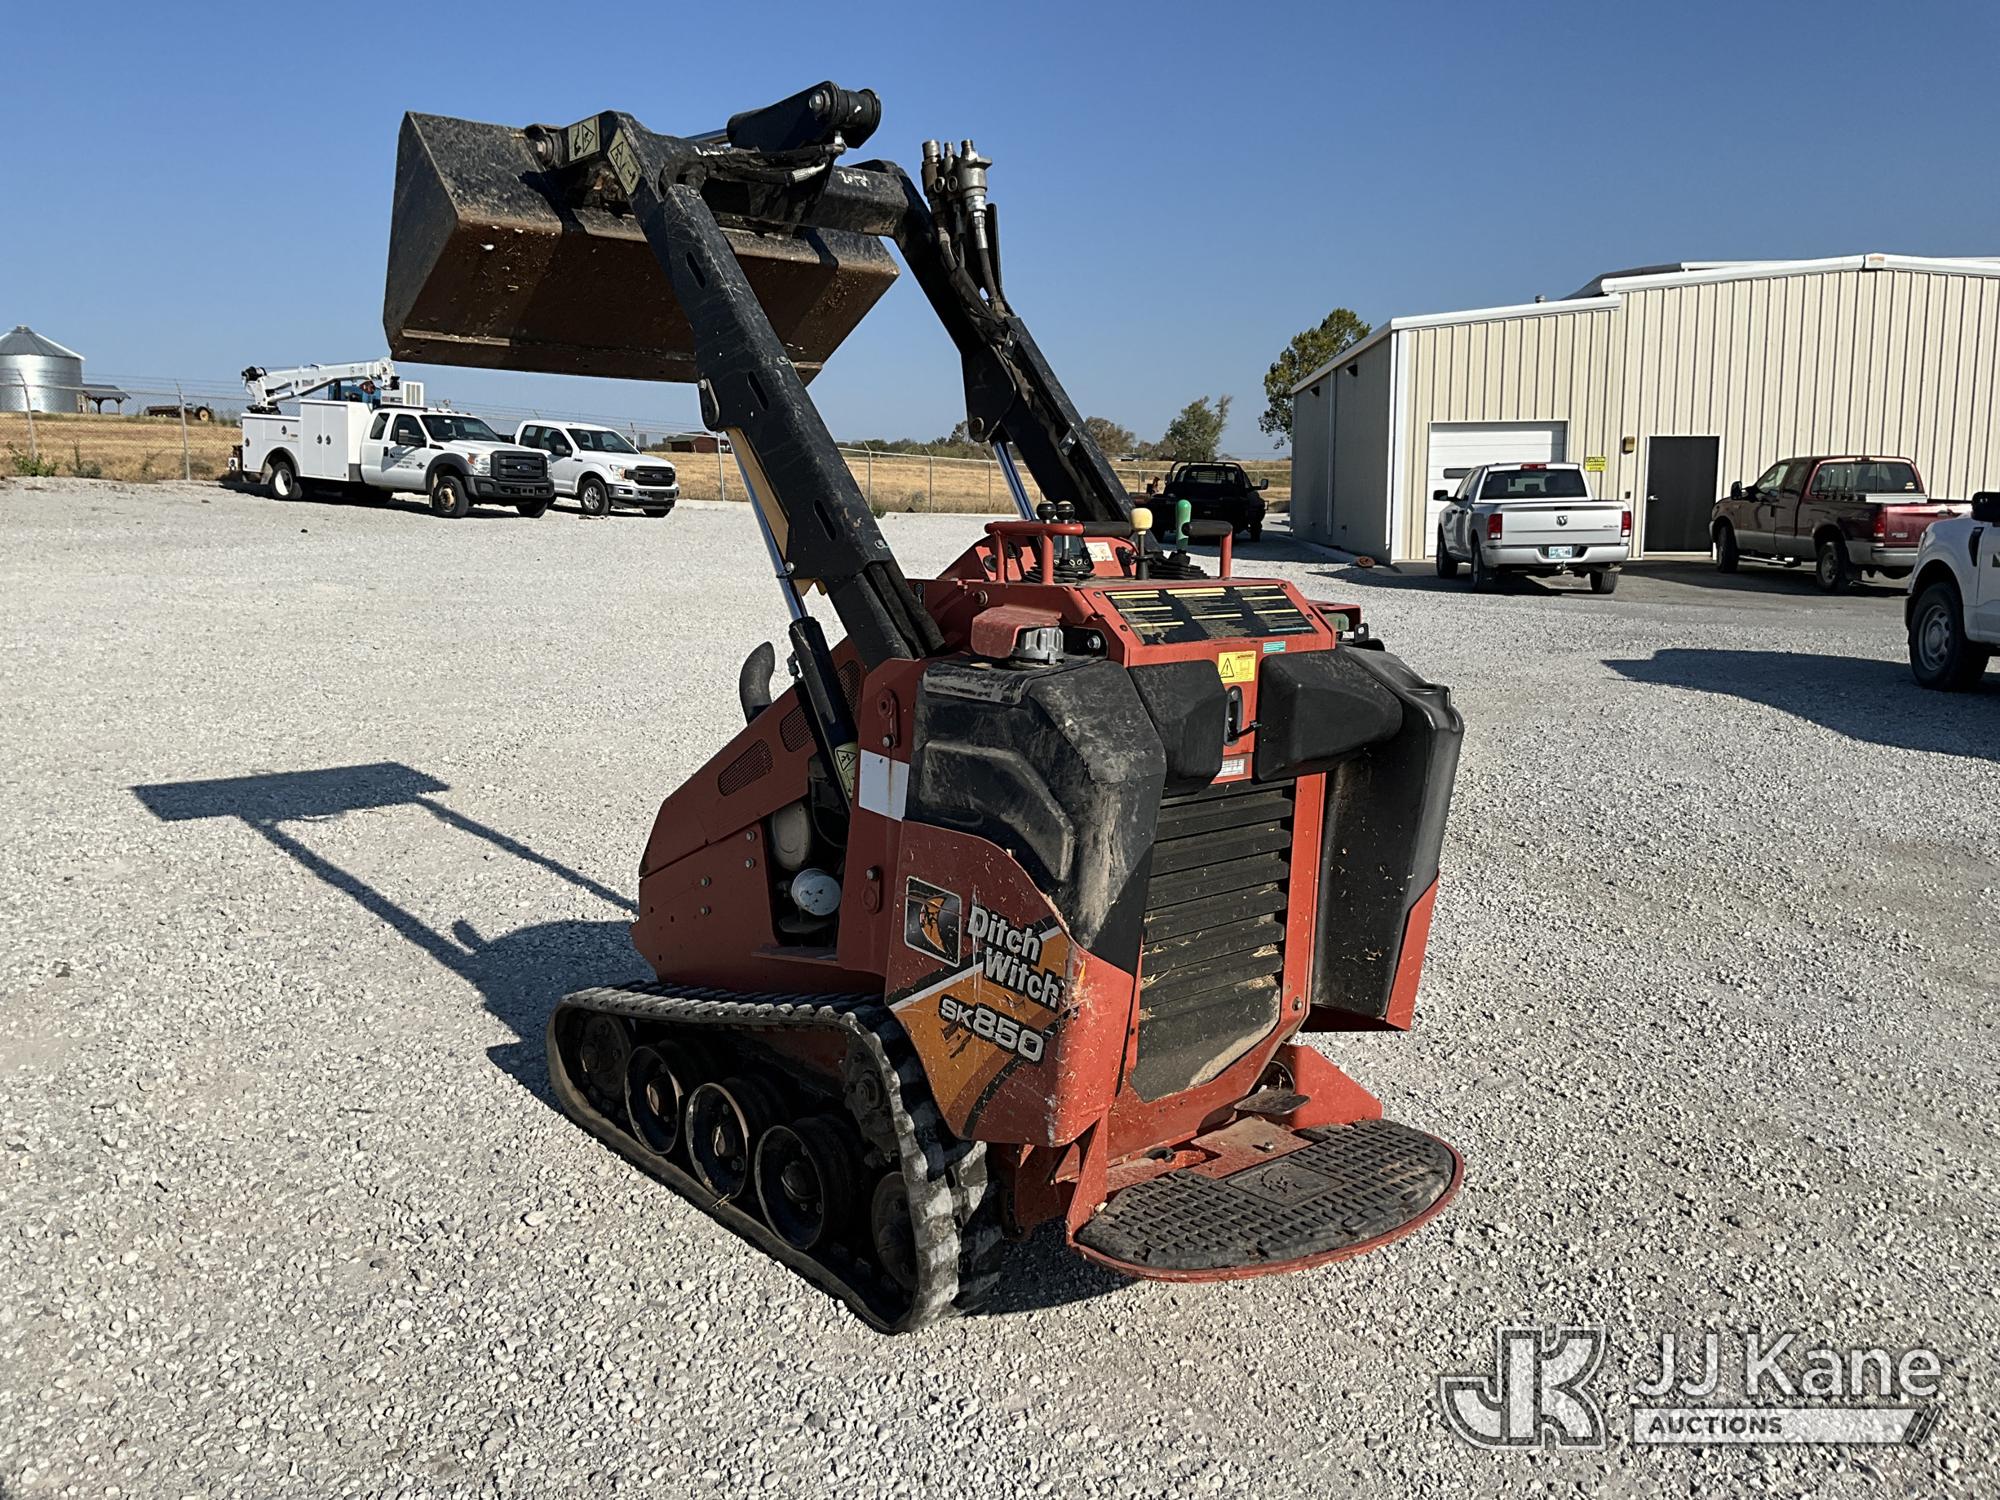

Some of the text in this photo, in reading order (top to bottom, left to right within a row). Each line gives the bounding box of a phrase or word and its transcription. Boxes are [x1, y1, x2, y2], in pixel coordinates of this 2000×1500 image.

[968, 905, 1040, 961] Ditch
[985, 948, 1060, 1009] Witch
[941, 999, 1044, 1061] SK850
